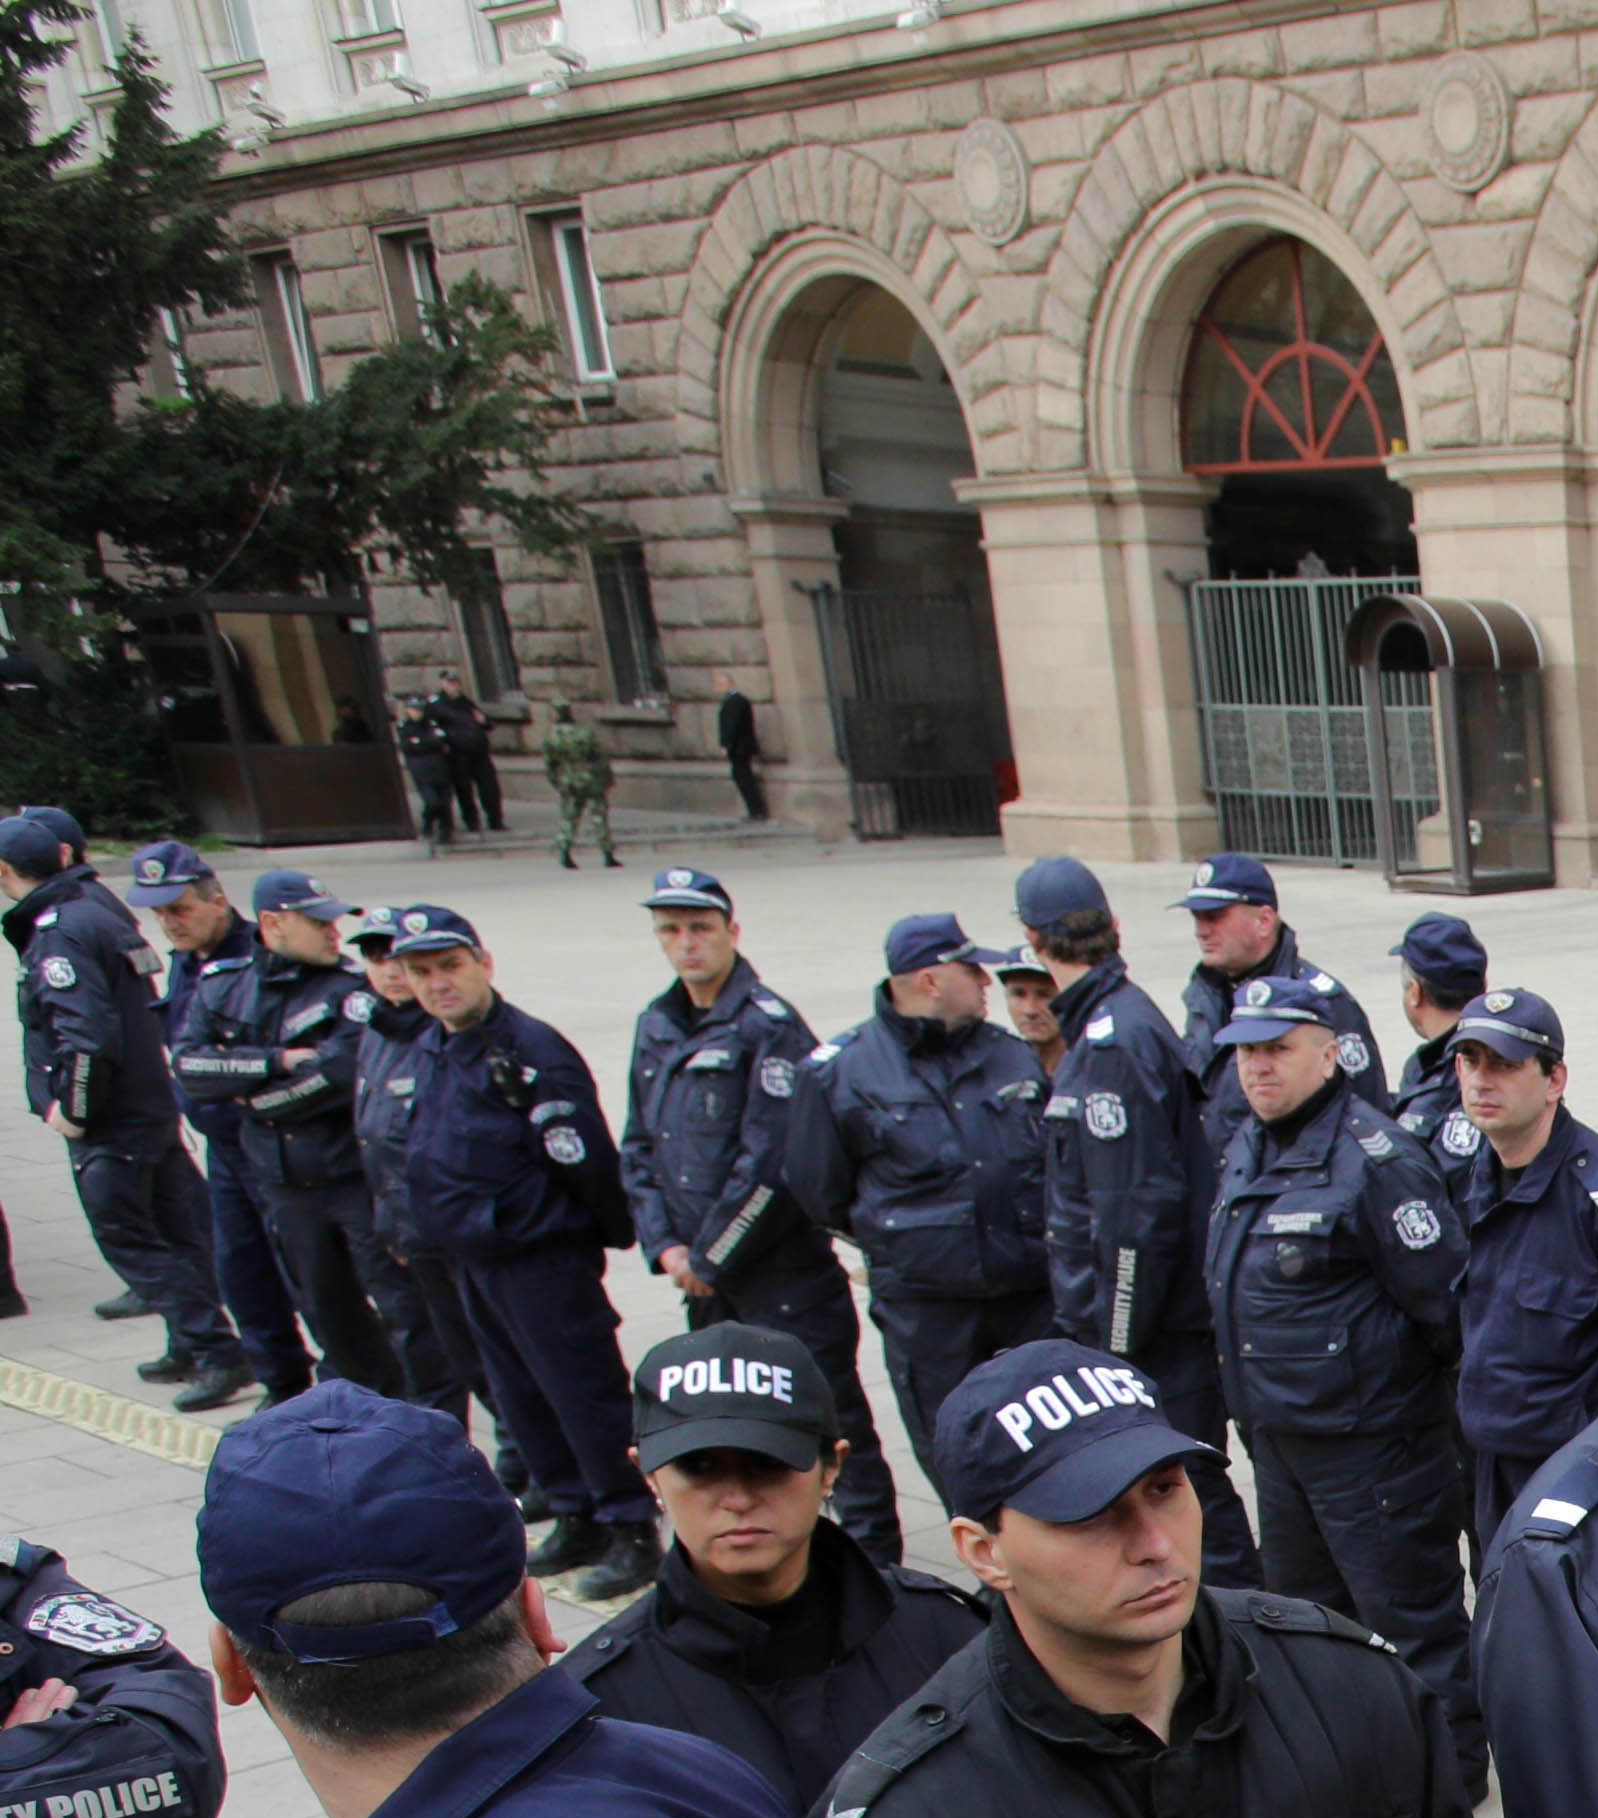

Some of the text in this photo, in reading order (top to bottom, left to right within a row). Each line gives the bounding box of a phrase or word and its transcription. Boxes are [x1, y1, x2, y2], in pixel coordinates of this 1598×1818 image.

[1110, 1246, 1137, 1353] SECURITY POLICE
[659, 1357, 793, 1404] POLICE
[995, 1367, 1156, 1453] POLICE
